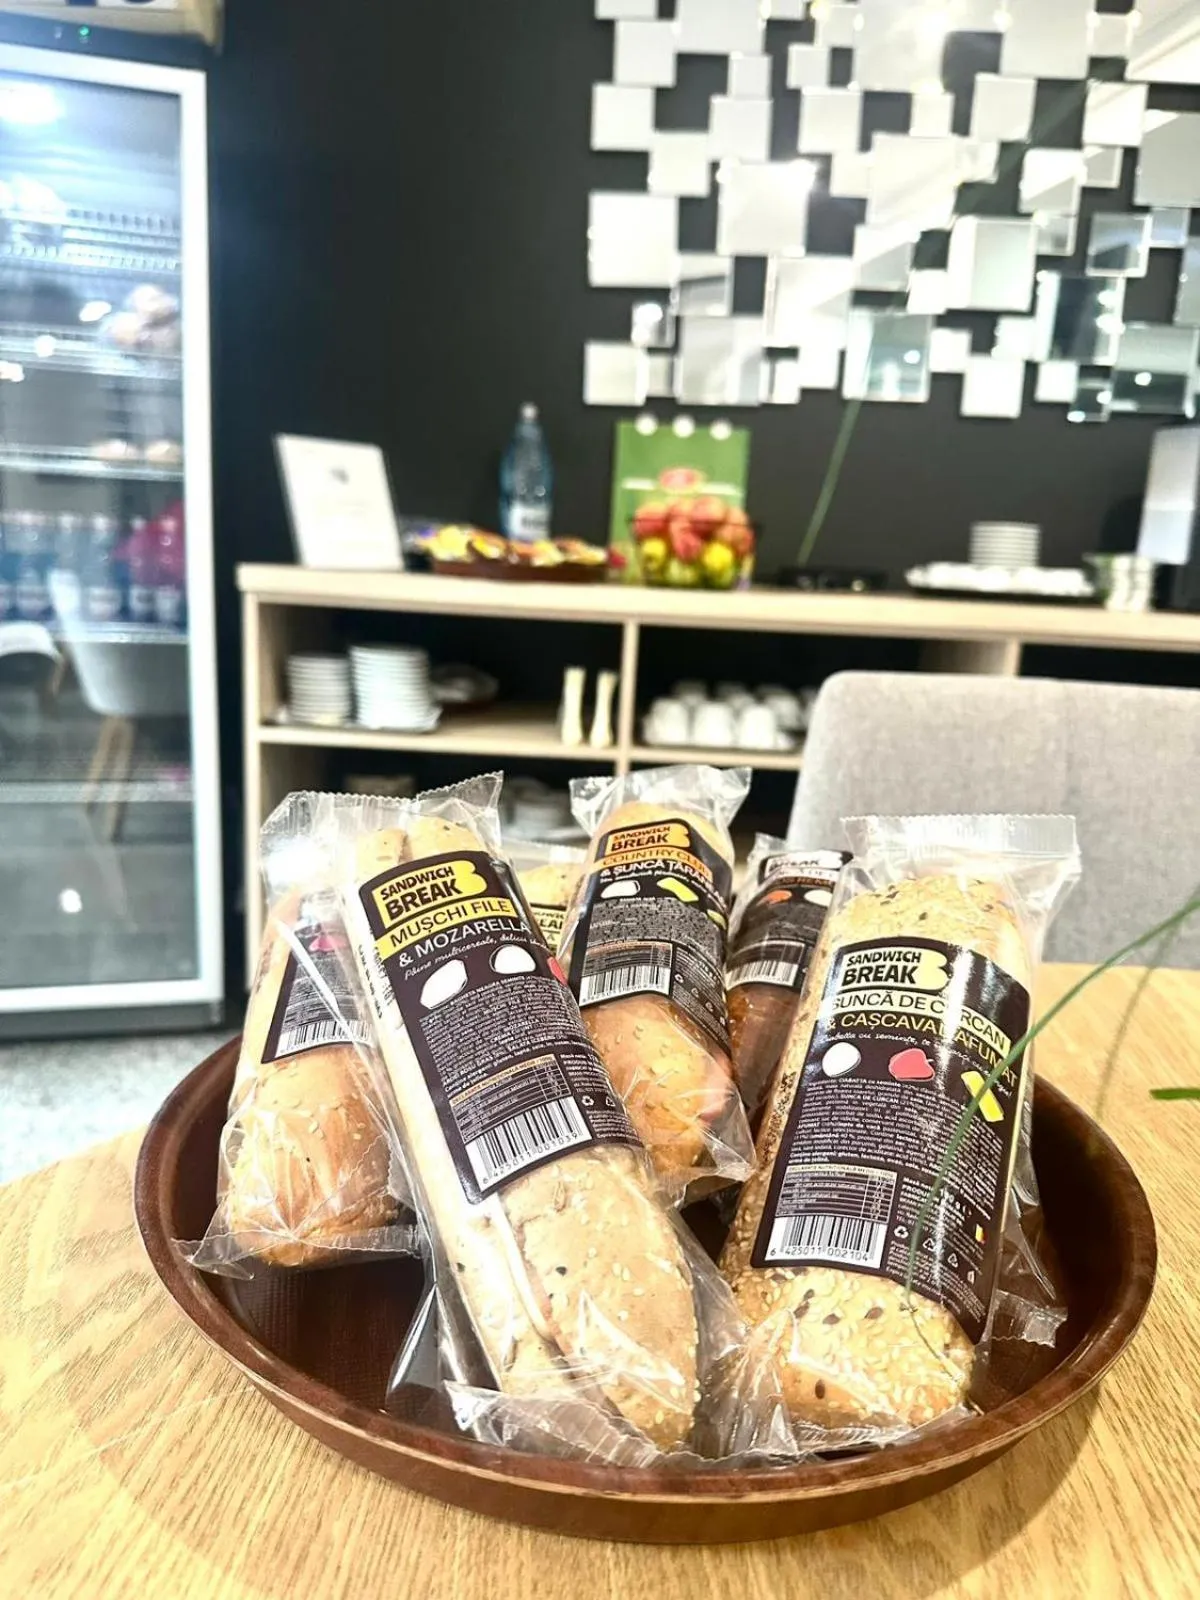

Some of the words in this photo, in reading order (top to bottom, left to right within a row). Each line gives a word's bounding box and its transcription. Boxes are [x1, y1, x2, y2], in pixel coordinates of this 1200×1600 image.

[611, 833, 669, 852] BREAK
[613, 826, 671, 841] SANDWICH
[602, 849, 675, 866] COUNTRY
[380, 866, 455, 901] SANDWICH
[385, 879, 463, 921] BREAK
[471, 900, 512, 918] FILE
[399, 952, 414, 967] &
[414, 918, 532, 958] MOZARELLA
[847, 951, 922, 968] SANDWICH
[841, 965, 918, 987] BREAK
[898, 994, 927, 1010] DE
[930, 1000, 1006, 1050] CRCAN
[769, 1247, 777, 1257] 6
[784, 1246, 821, 1256] 425011
[827, 1247, 868, 1261] 002104
